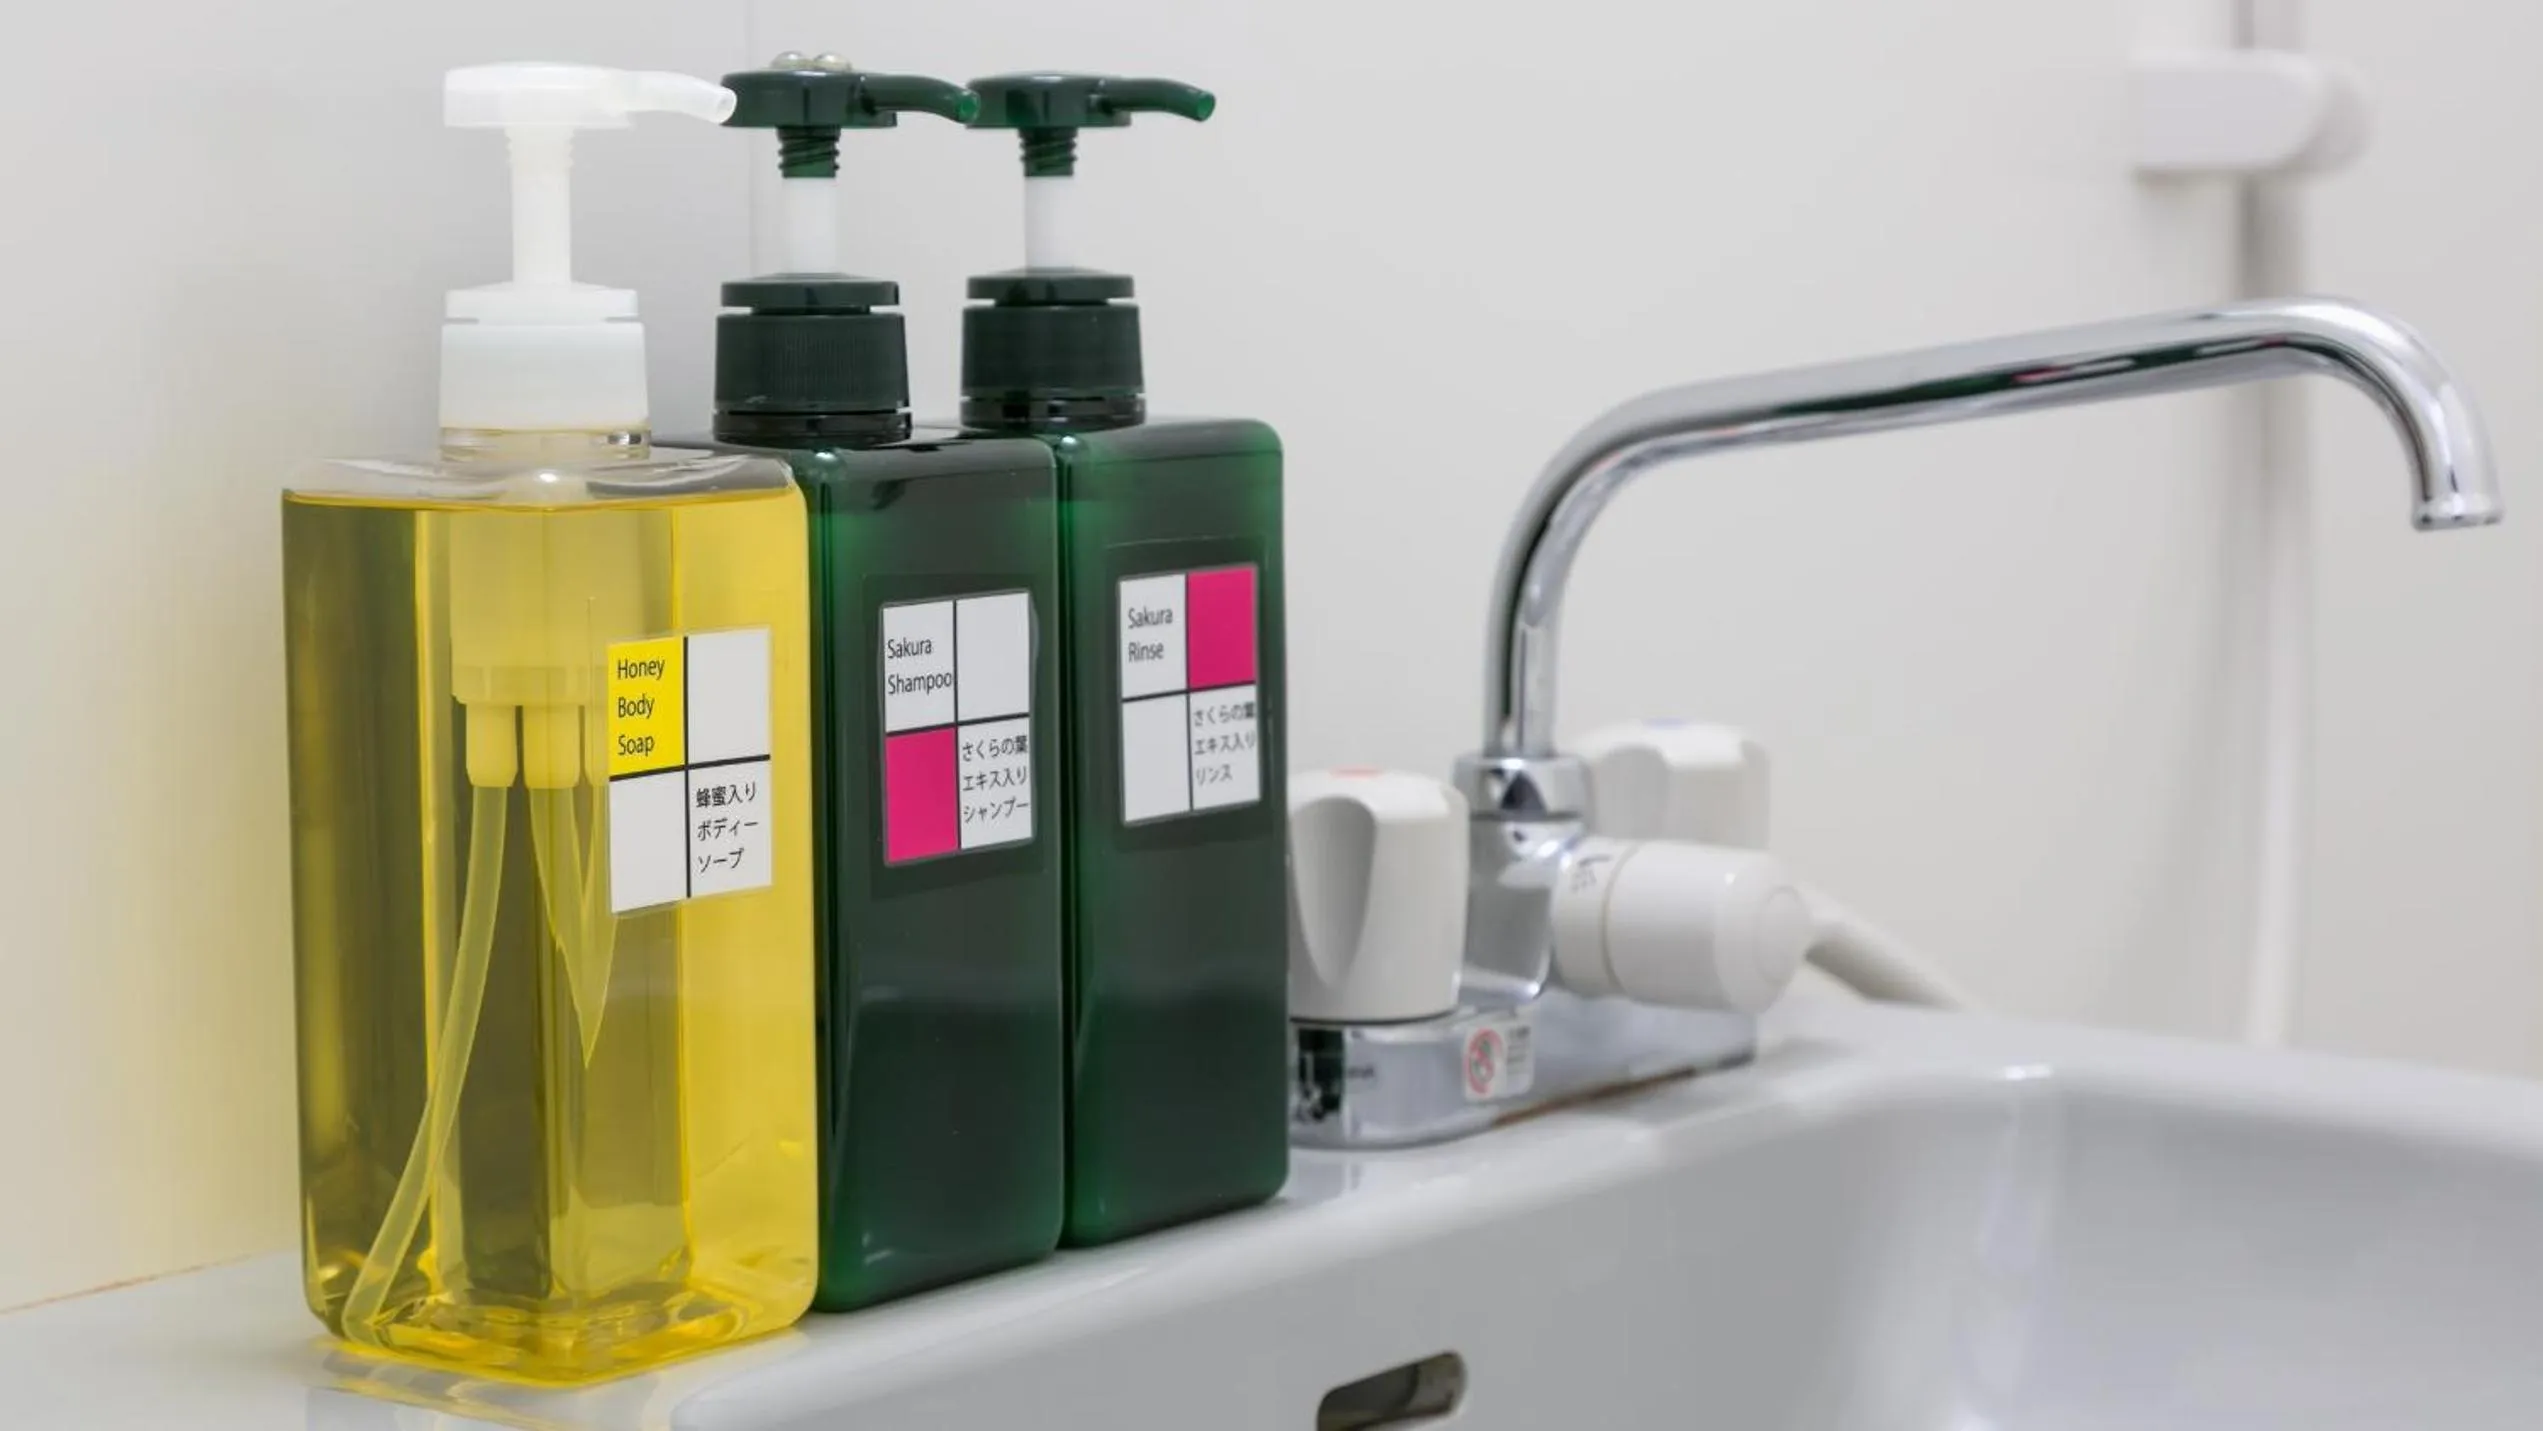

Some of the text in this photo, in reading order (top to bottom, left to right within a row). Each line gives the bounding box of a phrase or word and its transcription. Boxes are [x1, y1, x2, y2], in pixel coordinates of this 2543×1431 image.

[1128, 606, 1173, 629] Sakura
[887, 637, 932, 659] Sakura
[1128, 642, 1164, 663] Rinse
[617, 658, 665, 680] Honey
[887, 672, 952, 696] Shampoo
[617, 694, 655, 718] Body
[617, 734, 655, 756] Soap
[1193, 730, 1256, 756] エキス入り
[962, 766, 1028, 792] エキス入り
[1196, 764, 1233, 786] リンス
[696, 781, 757, 808] 蜂蜜入り
[963, 796, 1029, 823] シャンプー
[697, 818, 759, 841] ボディー
[698, 847, 744, 873] ソープ
